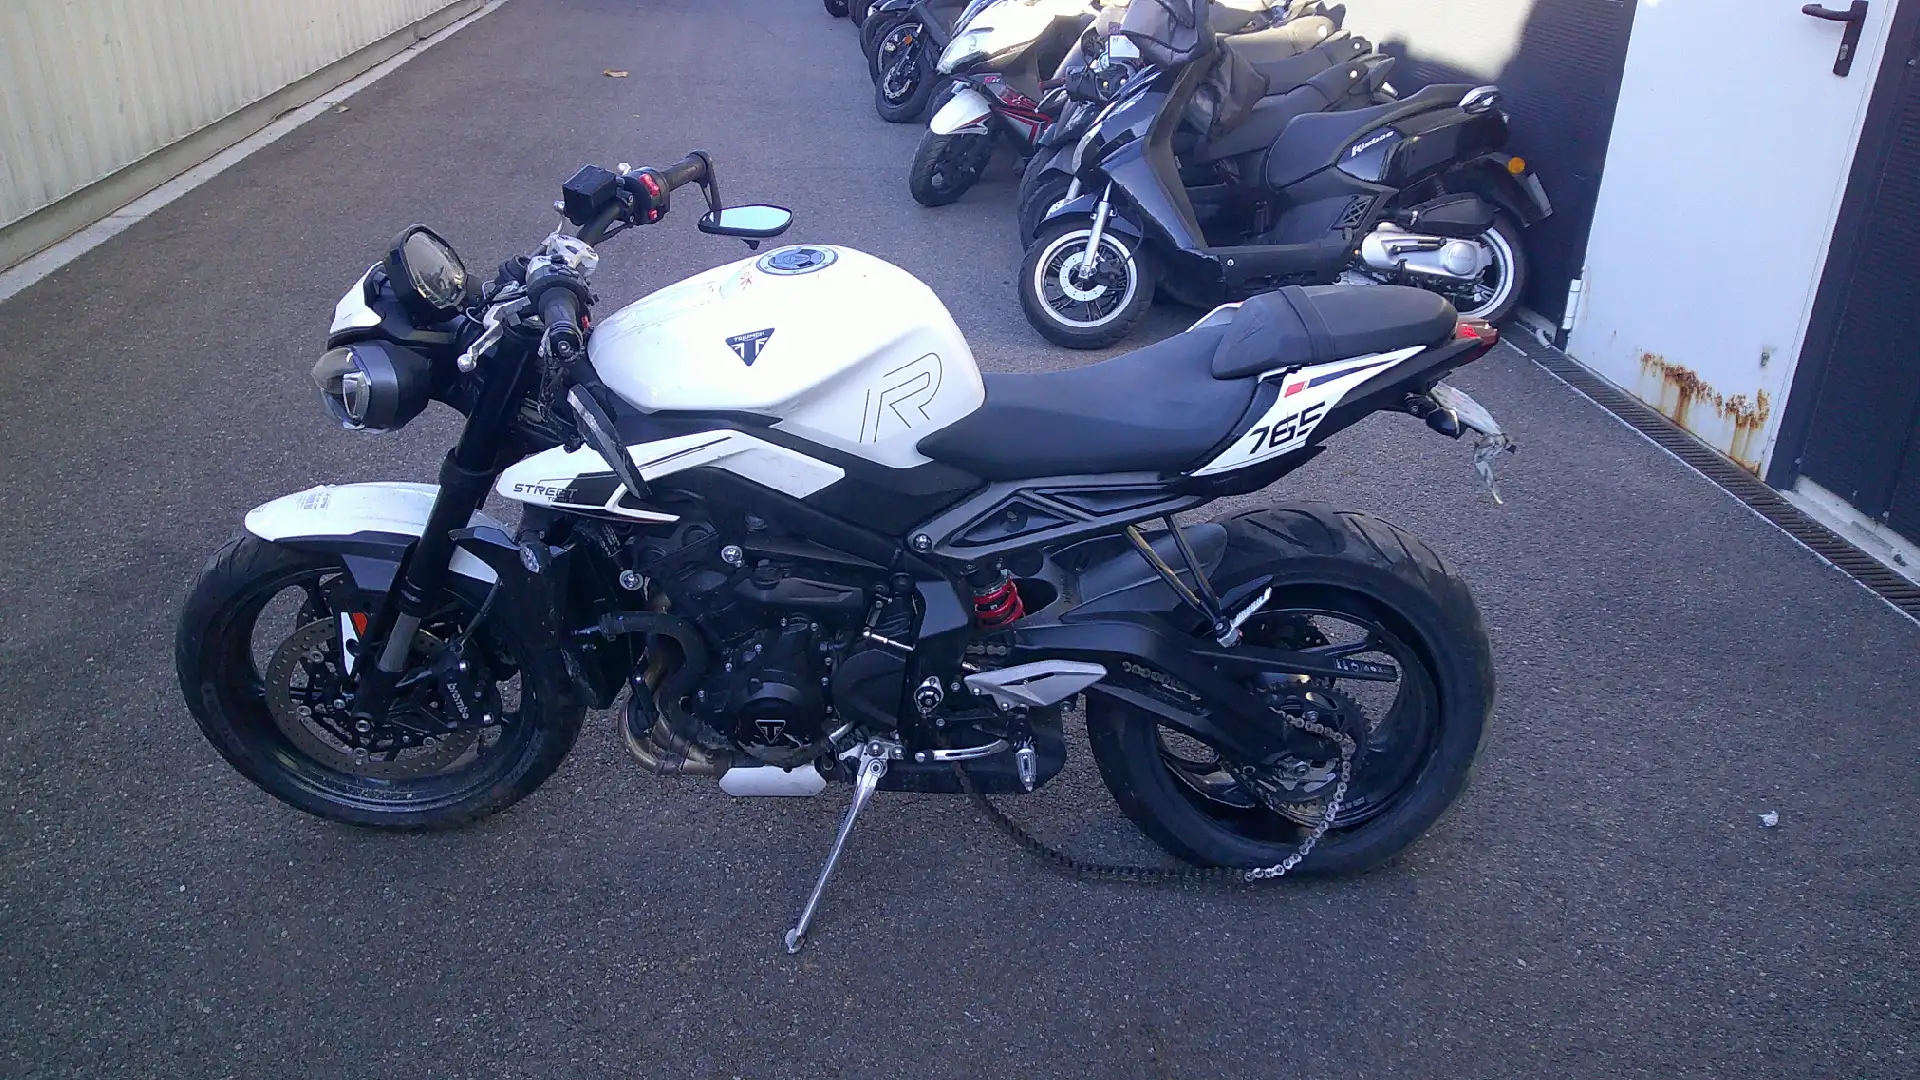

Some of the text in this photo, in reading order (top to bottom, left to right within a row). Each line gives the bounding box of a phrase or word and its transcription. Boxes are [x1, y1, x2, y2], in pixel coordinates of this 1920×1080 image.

[734, 331, 765, 342] TRIUMPH
[1249, 400, 1325, 455] 765
[513, 484, 578, 499] STREET
[446, 683, 469, 720] brembo
